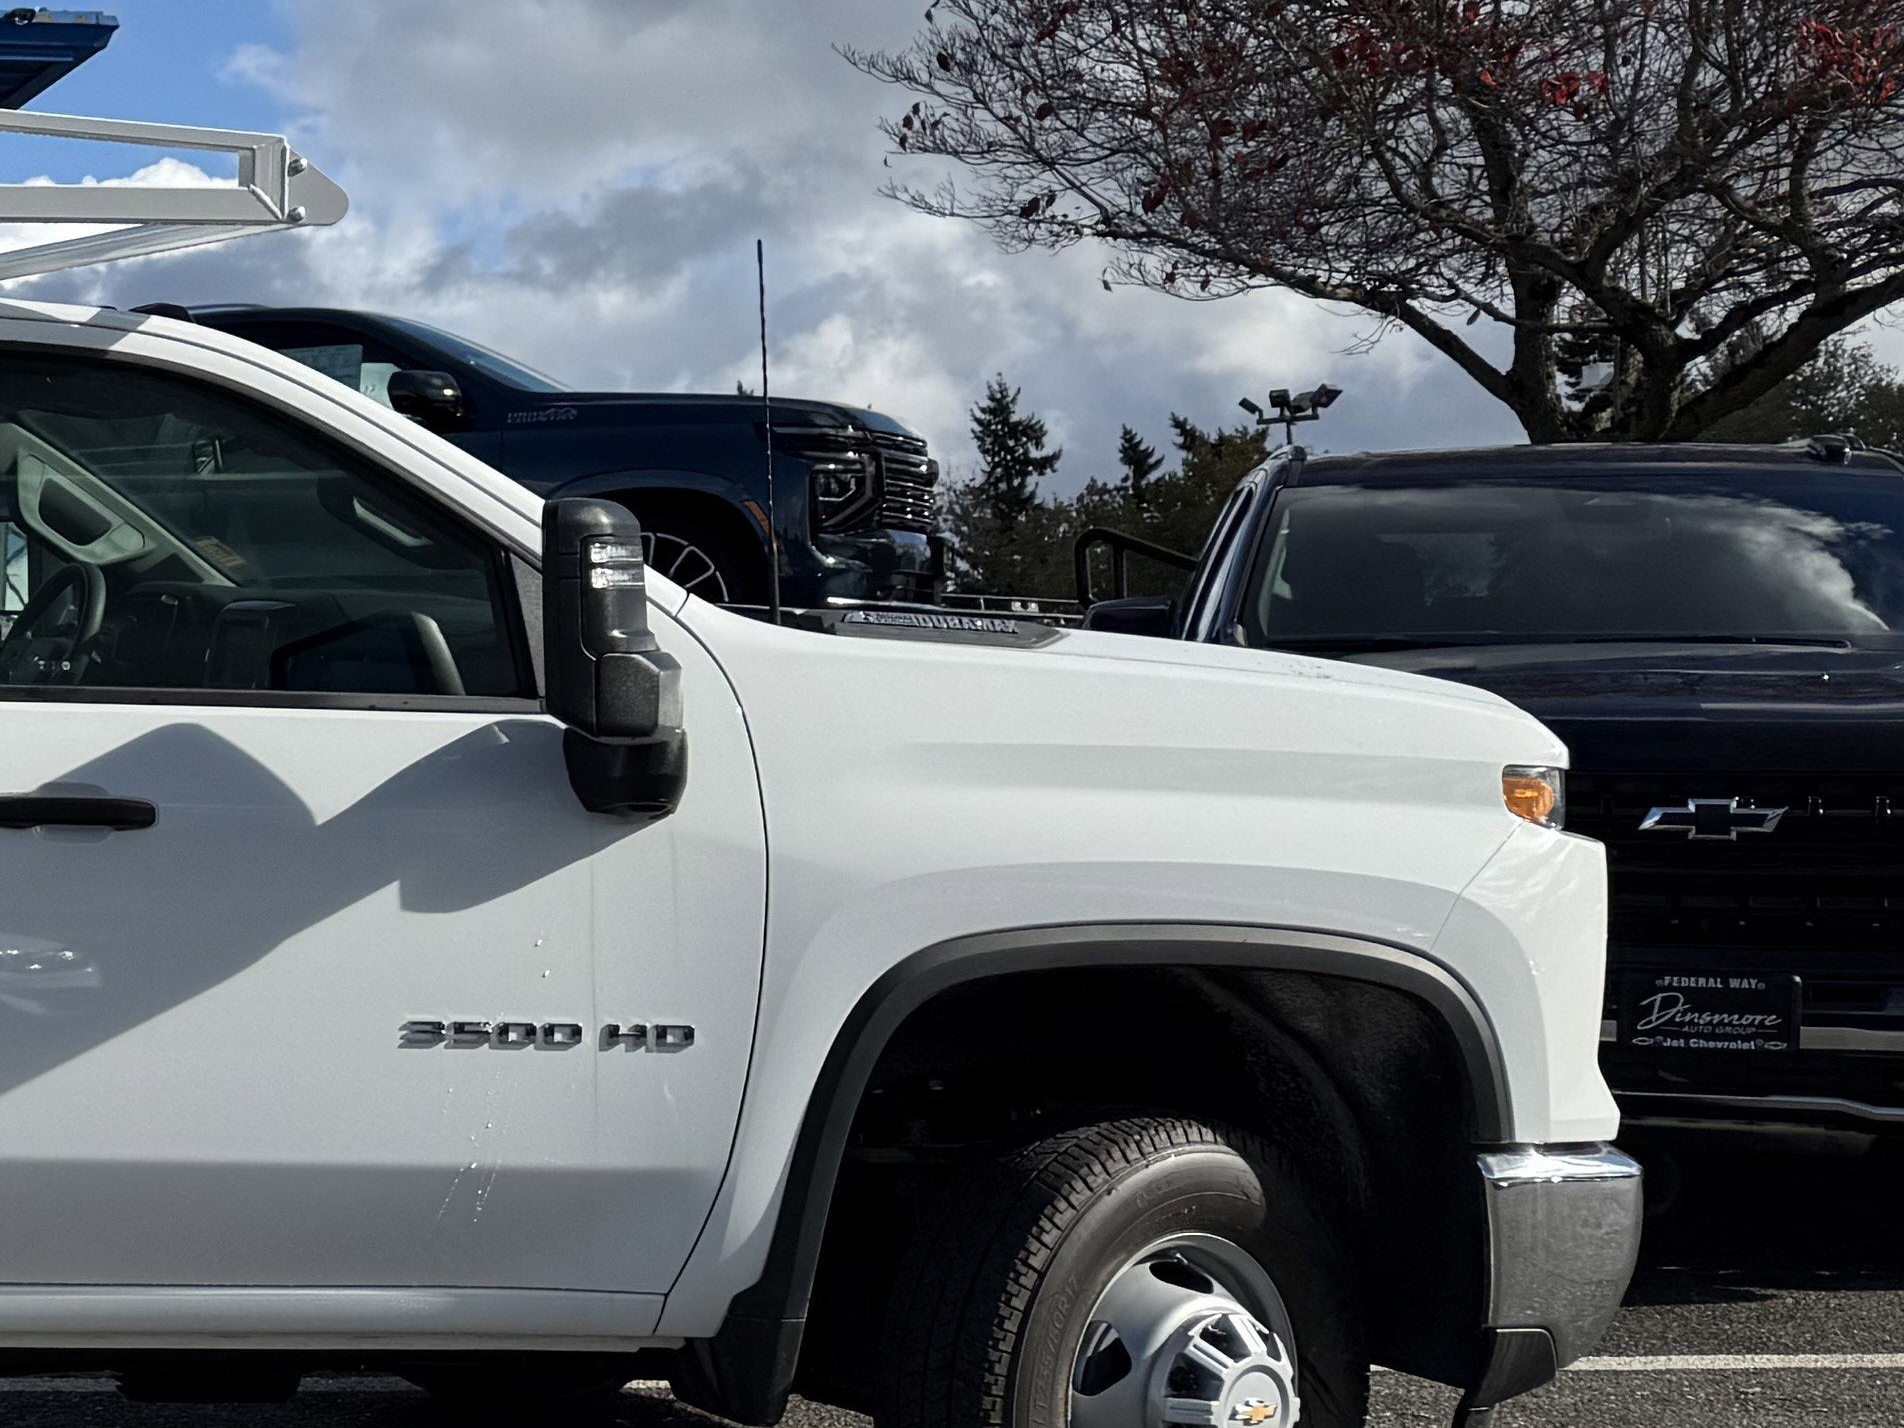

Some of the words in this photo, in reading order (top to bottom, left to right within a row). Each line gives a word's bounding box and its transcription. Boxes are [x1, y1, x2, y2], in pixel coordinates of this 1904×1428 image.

[1663, 975, 1724, 989] FEDERAL
[1728, 977, 1759, 990] WAY
[1636, 992, 1783, 1031] Dinsmore
[399, 1019, 583, 1048] 3500
[600, 1022, 695, 1051] HD
[1681, 1024, 1713, 1034] AUTO
[1714, 1025, 1757, 1035] GROUP
[1662, 1037, 1686, 1048] Jet
[1689, 1038, 1756, 1051] Chevrolet
